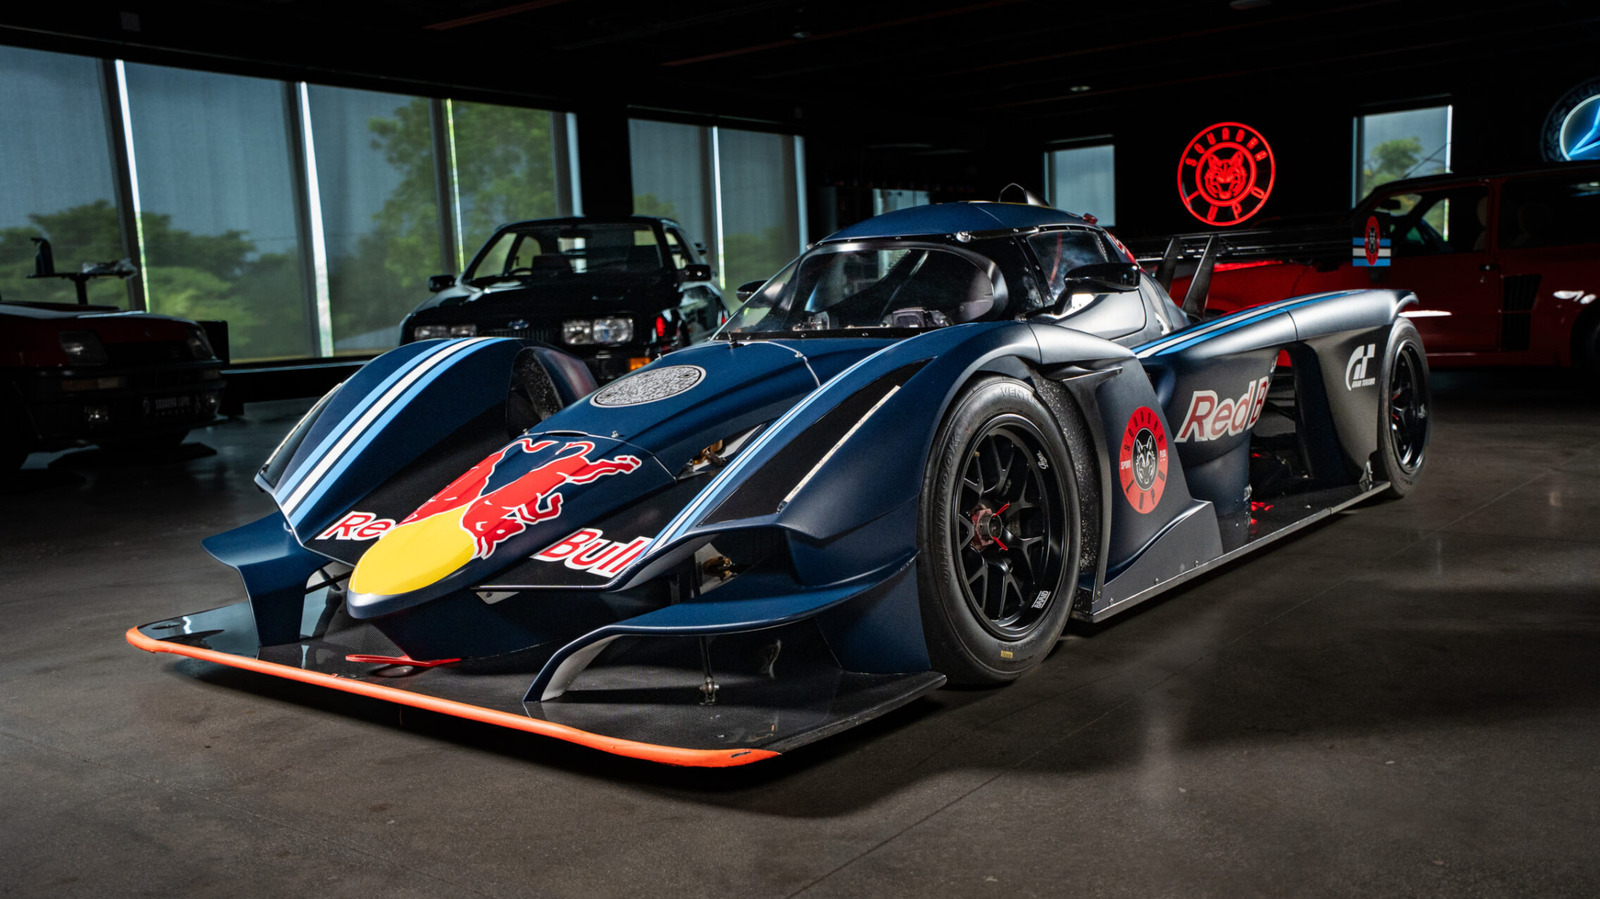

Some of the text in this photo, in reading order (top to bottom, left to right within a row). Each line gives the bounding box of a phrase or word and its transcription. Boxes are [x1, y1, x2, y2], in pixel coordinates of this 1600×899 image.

[1185, 127, 1268, 167] SQUADRA
[1186, 186, 1266, 221] LUPO
[1123, 411, 1165, 452] SQUADRA
[1174, 380, 1257, 442] Red
[1125, 469, 1166, 510] LUPO
[529, 527, 654, 578] Bull
